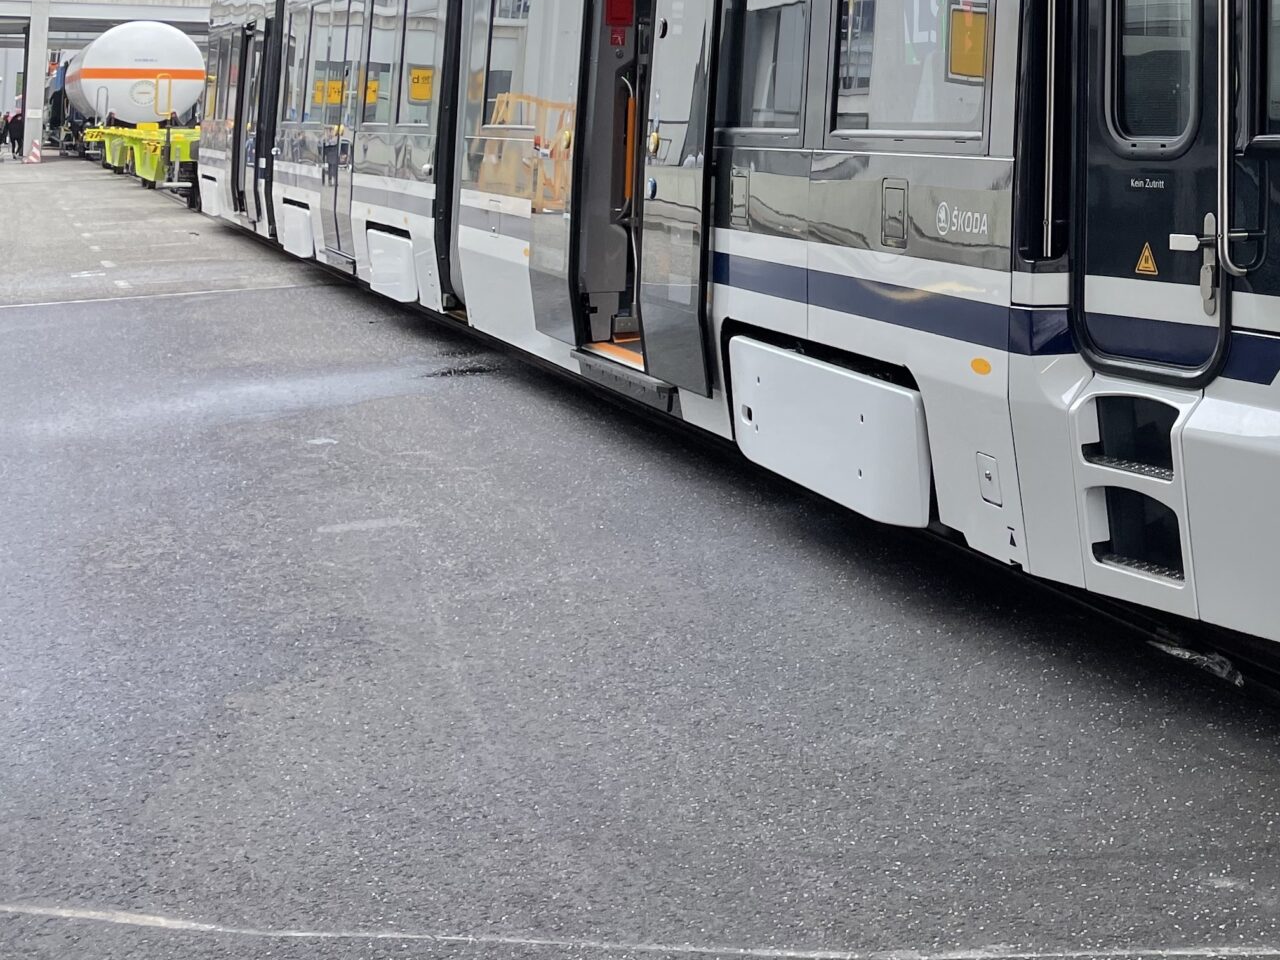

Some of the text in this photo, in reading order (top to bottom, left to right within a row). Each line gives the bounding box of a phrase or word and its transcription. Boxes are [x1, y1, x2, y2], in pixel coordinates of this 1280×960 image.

[1130, 178, 1165, 189] Kein Zutritt
[951, 206, 988, 235] ŠKODA
